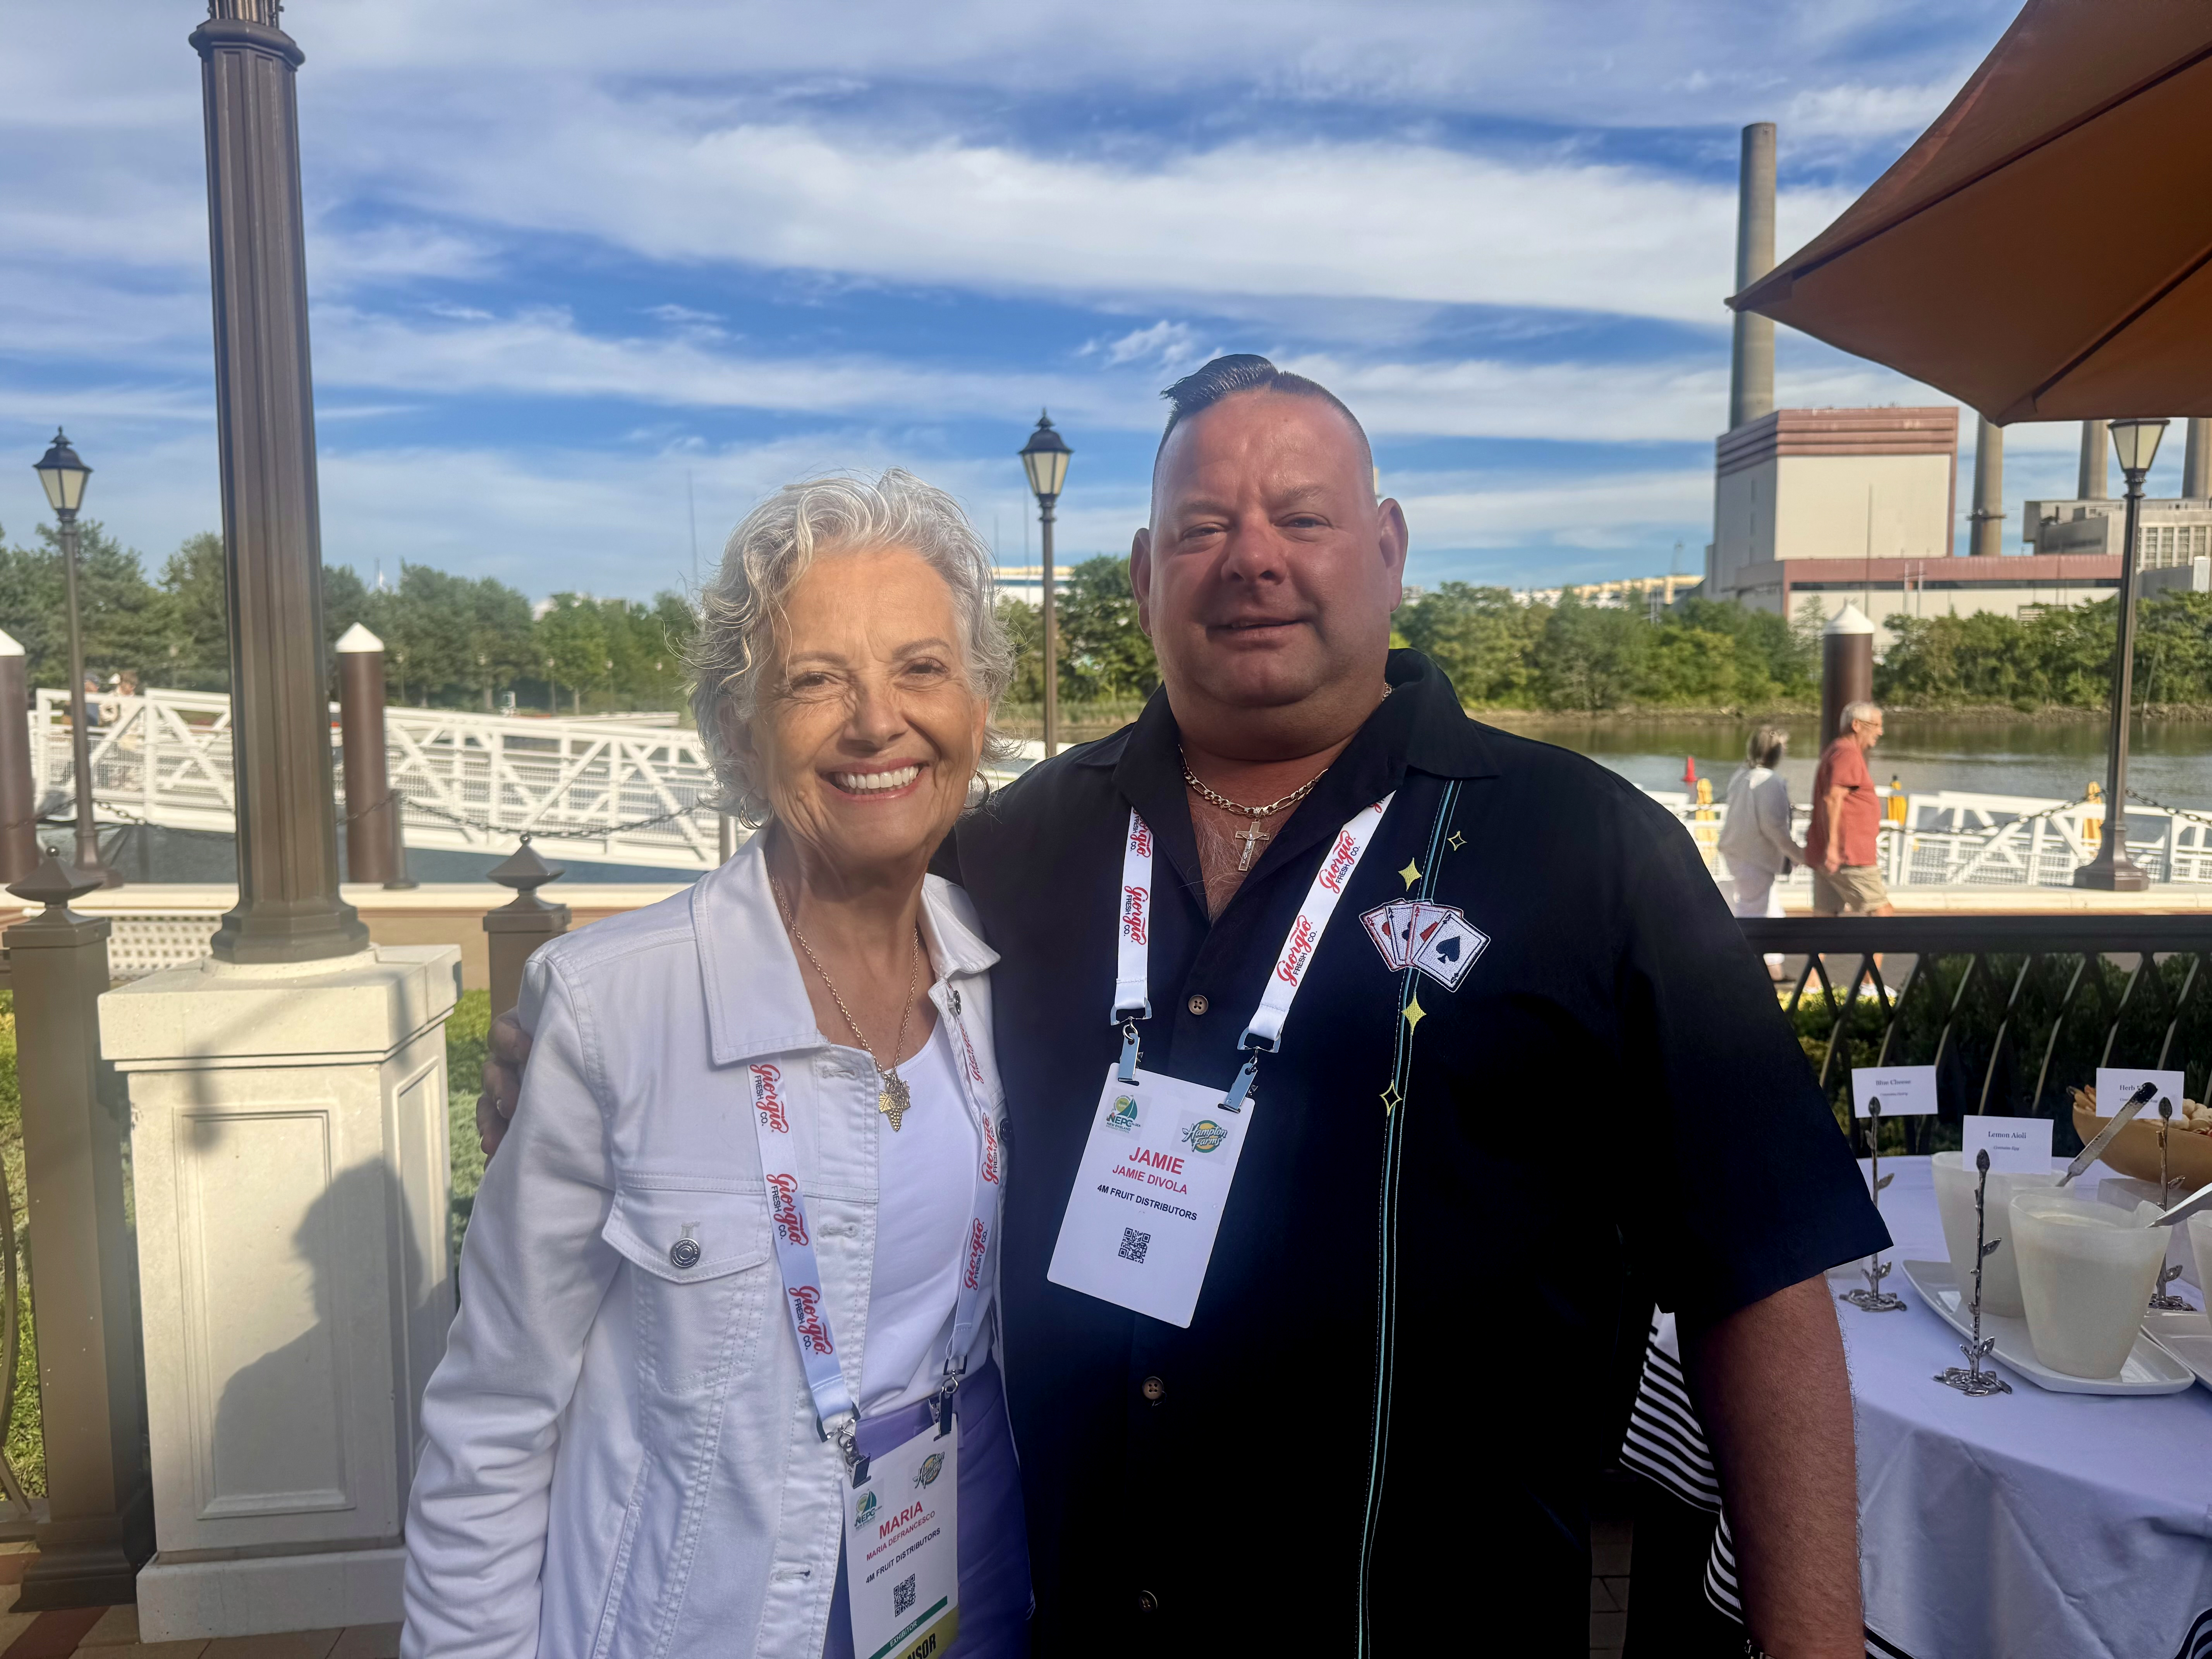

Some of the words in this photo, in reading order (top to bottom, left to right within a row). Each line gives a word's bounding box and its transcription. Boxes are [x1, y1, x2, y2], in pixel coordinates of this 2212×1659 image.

[1319, 830, 1355, 894] Giorgio
[1335, 864, 1350, 884] FRESH
[1350, 846, 1360, 856] CO.
[1123, 886, 1148, 945] Giorgio
[1277, 915, 1312, 987] Giorgio
[1293, 952, 1307, 975] FRESH
[1308, 931, 1317, 942] CO.
[750, 1064, 789, 1133] Giorgio
[755, 1075, 764, 1100] FRESH
[1108, 1114, 1133, 1128] NEPC
[1182, 1123, 1228, 1142] Hampton
[982, 1113, 999, 1185] Giorgio
[1129, 1147, 1185, 1175] JAMIE
[1192, 1137, 1222, 1152] Farms
[1113, 1165, 1146, 1182] JAMIE
[1147, 1174, 1187, 1194] DIVOLA
[766, 1174, 809, 1246] Giorgio
[771, 1185, 781, 1212] FRESH
[778, 1224, 787, 1239] CO.
[1097, 1185, 1109, 1194] 4M
[1110, 1188, 1135, 1201] FRUIT
[1135, 1196, 1197, 1220] DISTRIBUTORS
[964, 1218, 985, 1290] Giorgio
[974, 1255, 982, 1278] FRESH
[788, 1286, 833, 1355] Giorgio
[794, 1298, 805, 1324] FRESH
[803, 1335, 811, 1350] CO.
[855, 1508, 875, 1526] NEPC
[867, 1543, 887, 1561] MARIA
[888, 1511, 935, 1546] DEFRANCESCO
[879, 1501, 923, 1539] MARIA
[866, 1572, 874, 1583] 4M
[876, 1559, 894, 1577] FRUIT
[896, 1527, 940, 1563] DISTRIBUTORS
[890, 1620, 917, 1647] EXHIBITOR
